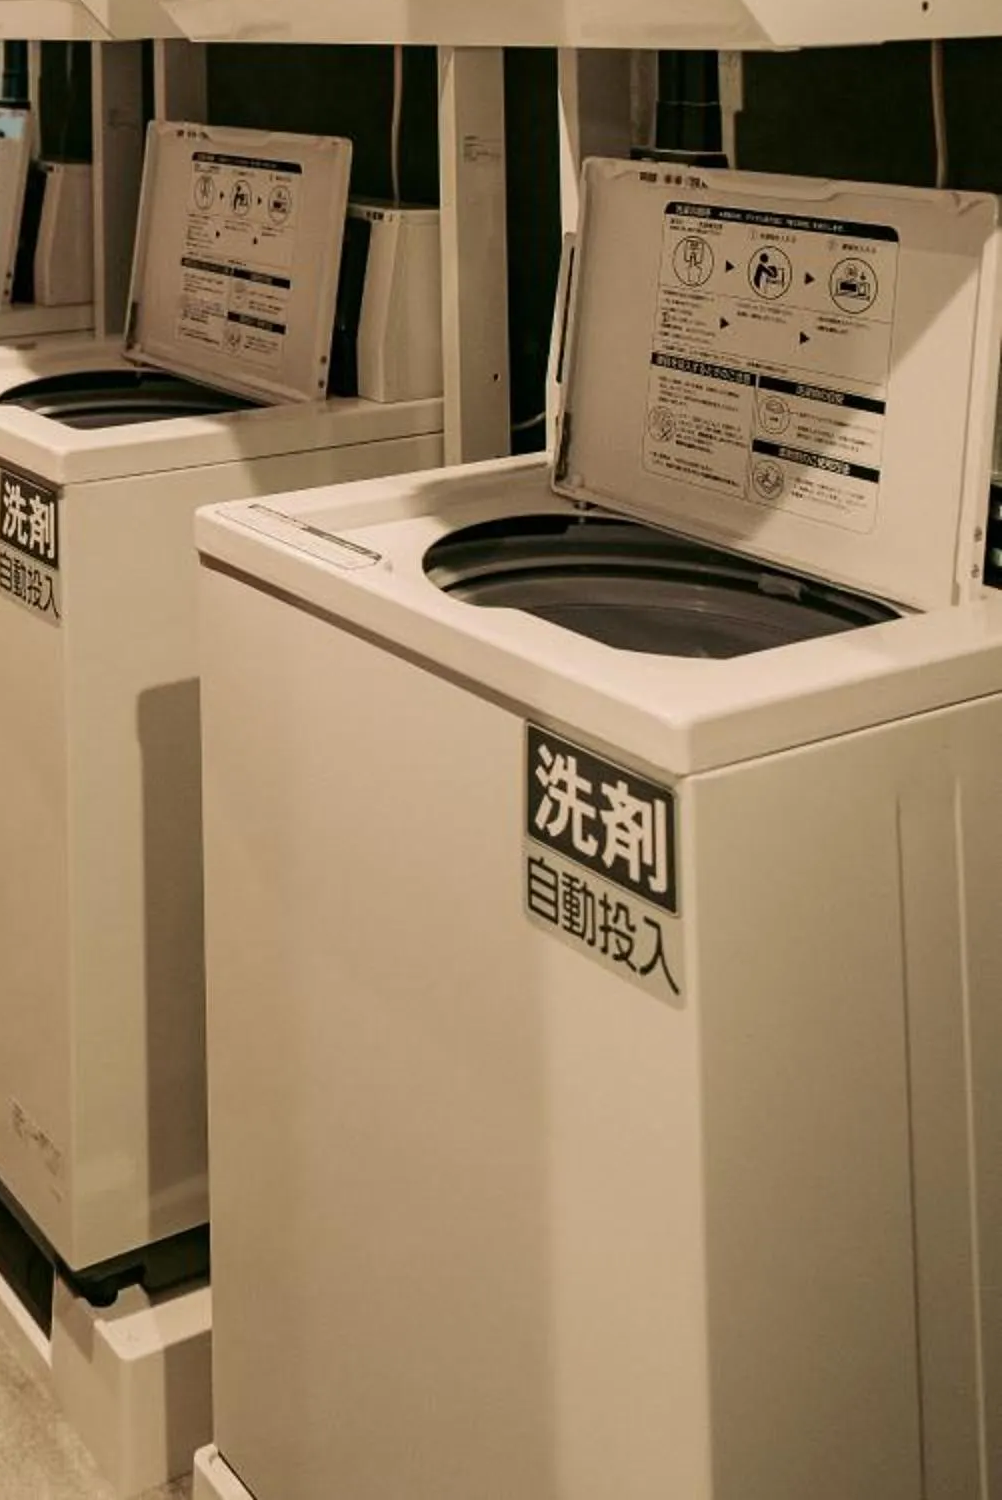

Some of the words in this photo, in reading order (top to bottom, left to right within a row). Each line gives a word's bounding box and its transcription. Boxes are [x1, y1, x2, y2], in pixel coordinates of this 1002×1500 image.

[2, 481, 55, 559] 洗剤
[0, 551, 61, 620] 自動投入
[535, 744, 667, 893] 洗剤
[528, 857, 680, 995] 自動投入
